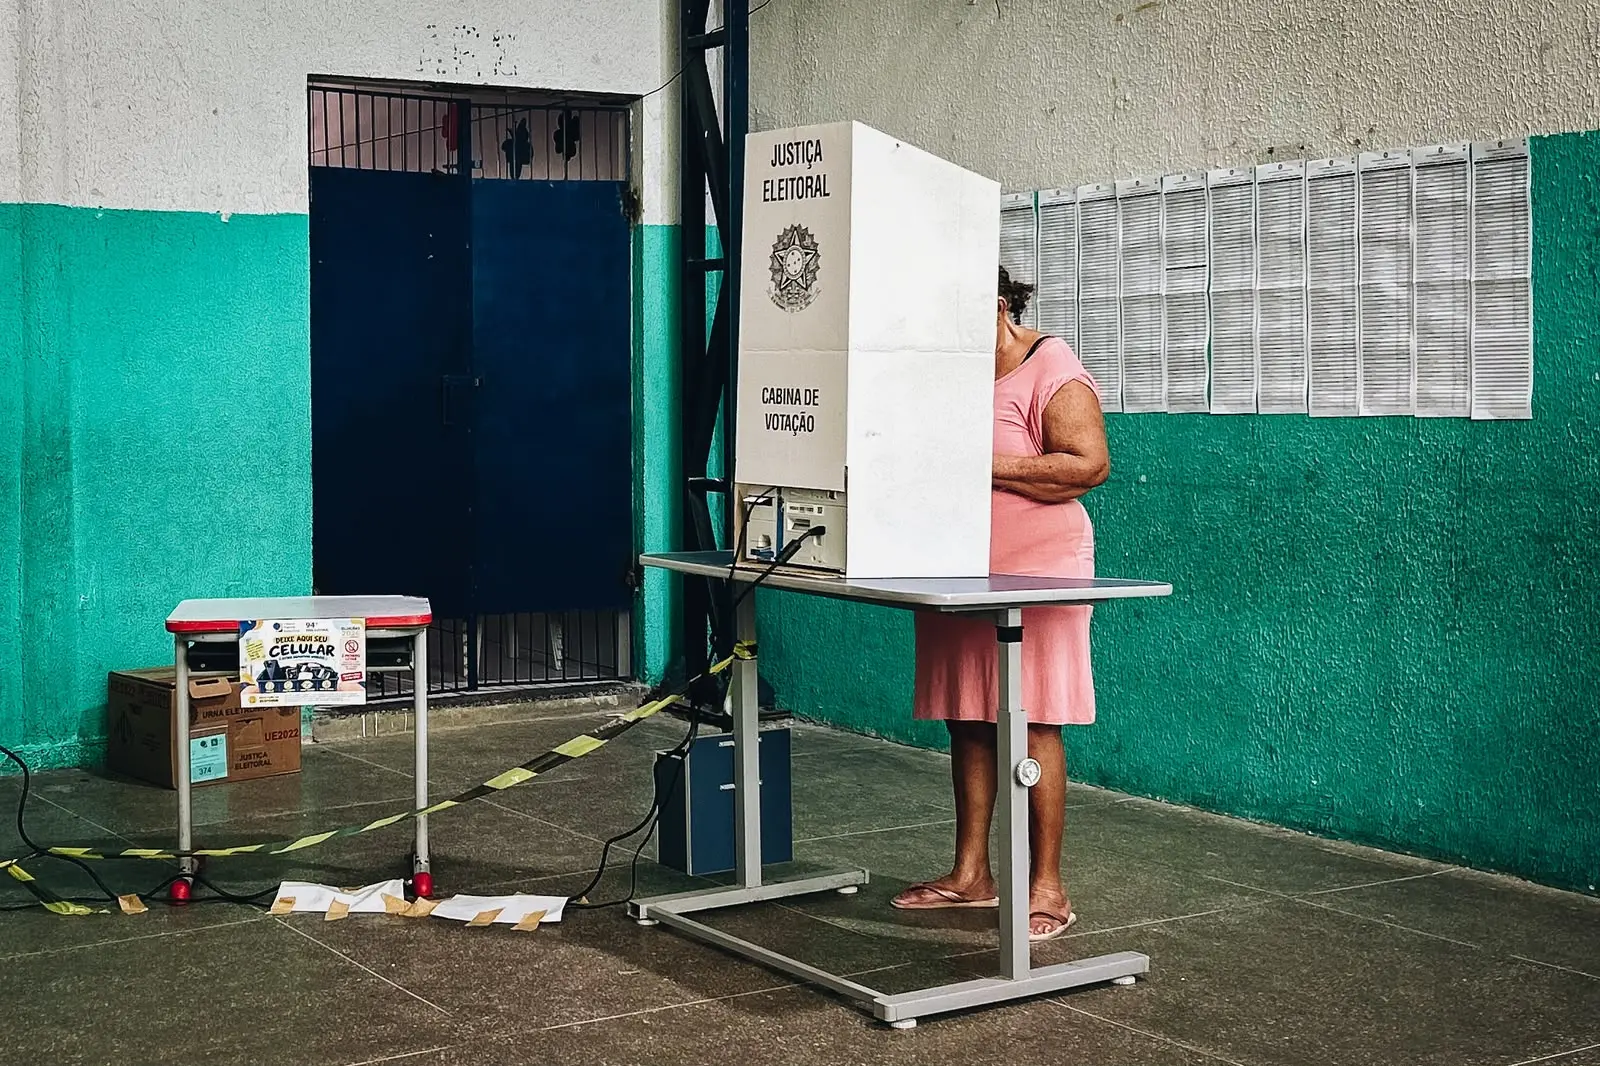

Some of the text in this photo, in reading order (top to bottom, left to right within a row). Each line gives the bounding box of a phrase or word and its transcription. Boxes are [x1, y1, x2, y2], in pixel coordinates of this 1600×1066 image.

[771, 139, 823, 169] JUSTIÇA
[763, 174, 831, 202] ELEITORAL
[762, 387, 819, 406] CABINA DE
[765, 411, 815, 437] VOTAÇÃO
[275, 636, 294, 644] DEIXE
[269, 644, 335, 657] CELULAR
[202, 709, 224, 719] URNA
[264, 728, 299, 741] UE2022
[234, 760, 273, 770] ELEITORAL
